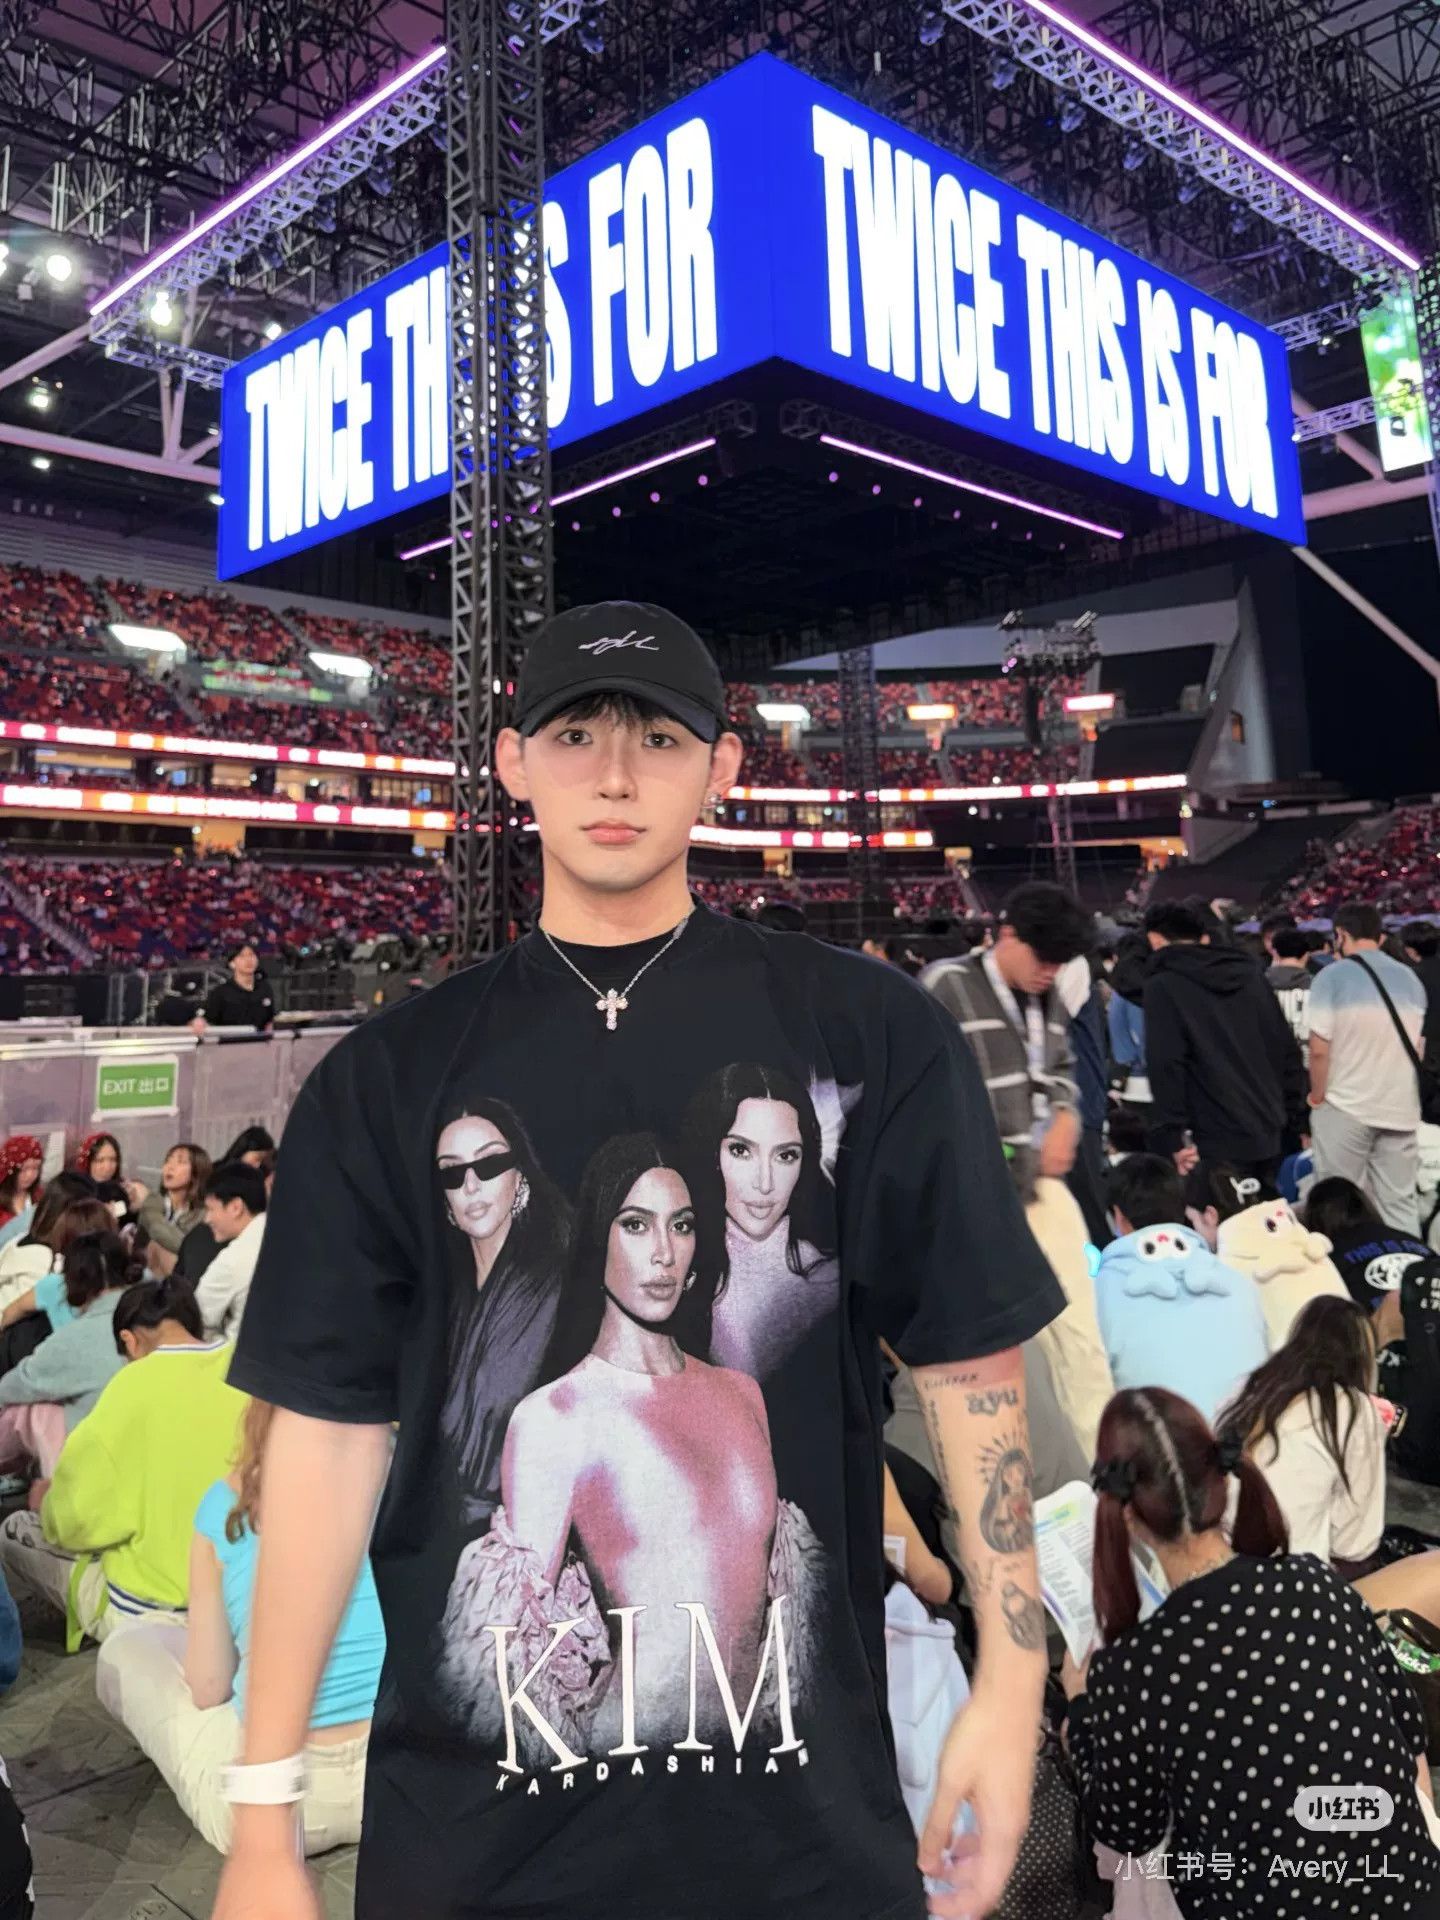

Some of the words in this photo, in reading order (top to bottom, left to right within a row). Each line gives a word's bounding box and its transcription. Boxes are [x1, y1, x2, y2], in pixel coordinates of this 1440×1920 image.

[246, 308, 374, 552] TWICE
[589, 117, 718, 406] FOR
[812, 104, 1011, 419] TWICE
[1016, 214, 1134, 465] THIS
[1137, 279, 1190, 486] IS
[1190, 307, 1278, 518] FOR
[103, 1078, 137, 1095] EXIT
[138, 1077, 169, 1094] 出口
[483, 1594, 805, 1773] KIM
